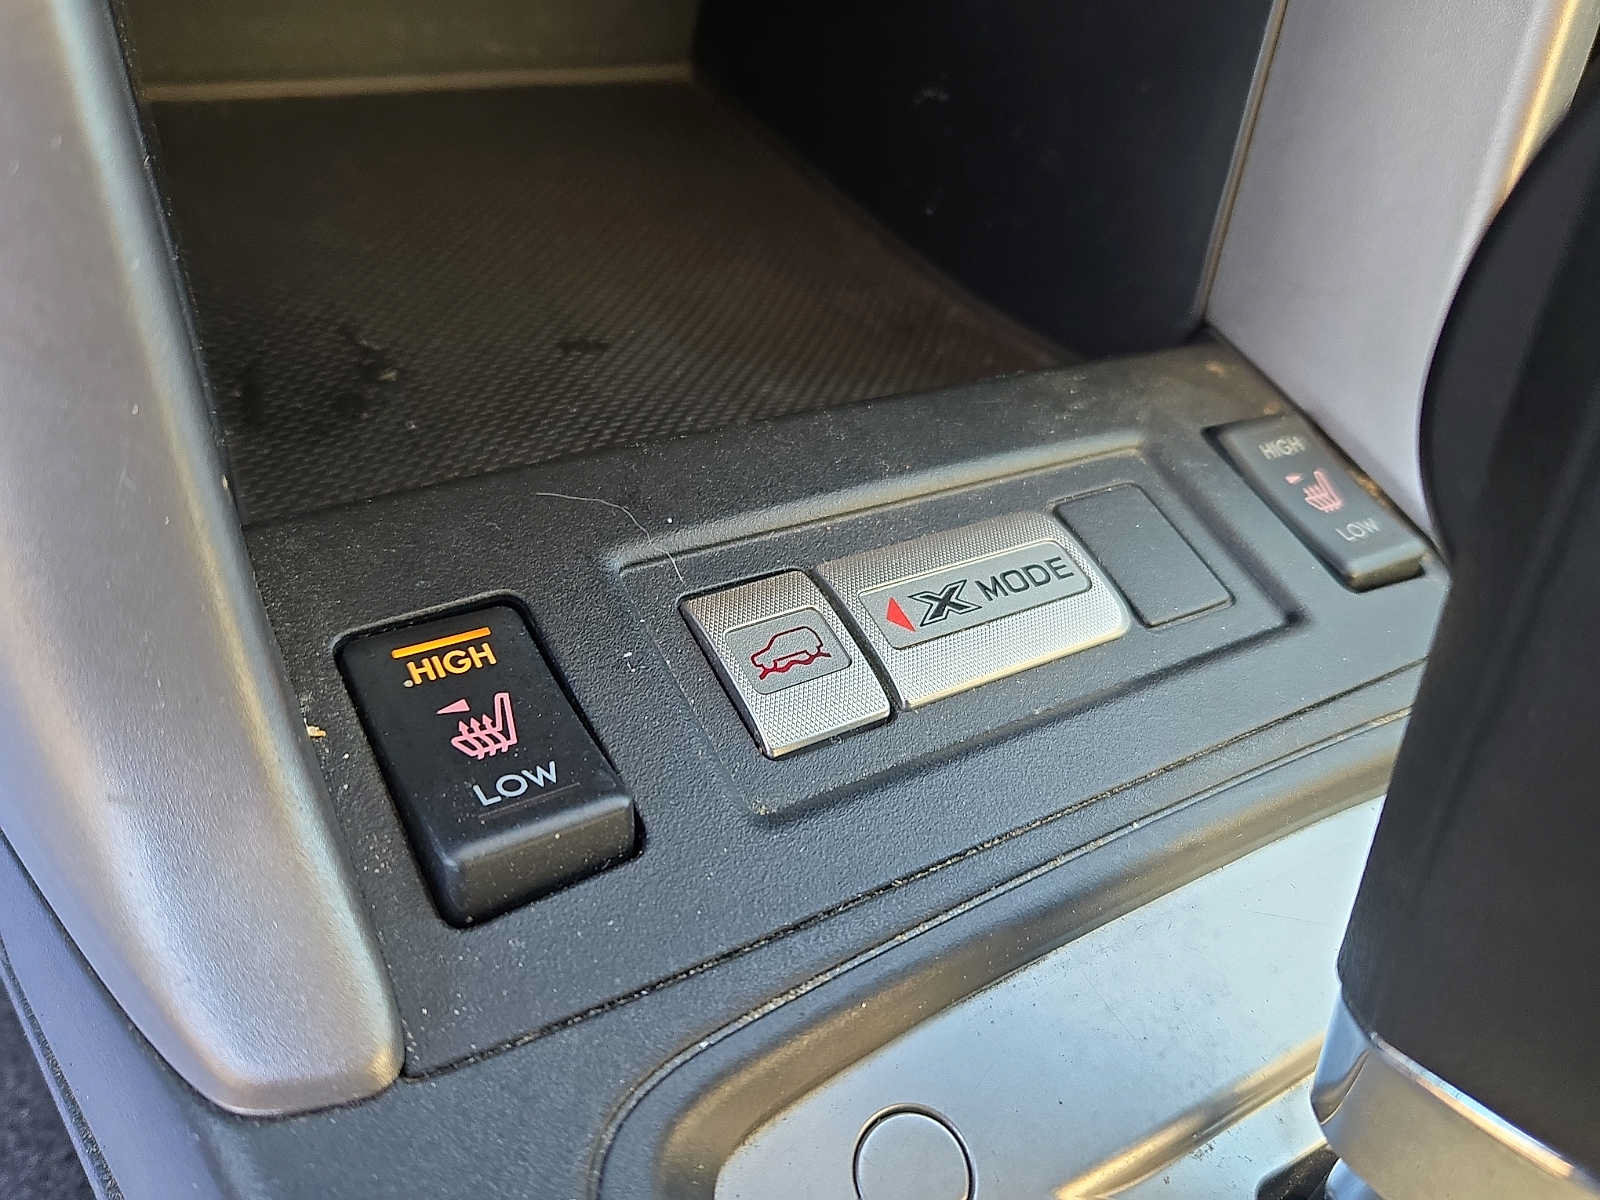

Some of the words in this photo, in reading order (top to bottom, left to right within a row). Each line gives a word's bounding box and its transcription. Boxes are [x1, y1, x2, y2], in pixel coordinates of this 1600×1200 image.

[1258, 436, 1306, 461] HIGH
[1335, 517, 1380, 542] LOW
[907, 578, 983, 628] X
[974, 556, 1075, 602] MODE
[406, 642, 497, 686] HIGH
[472, 760, 558, 807] LOW
